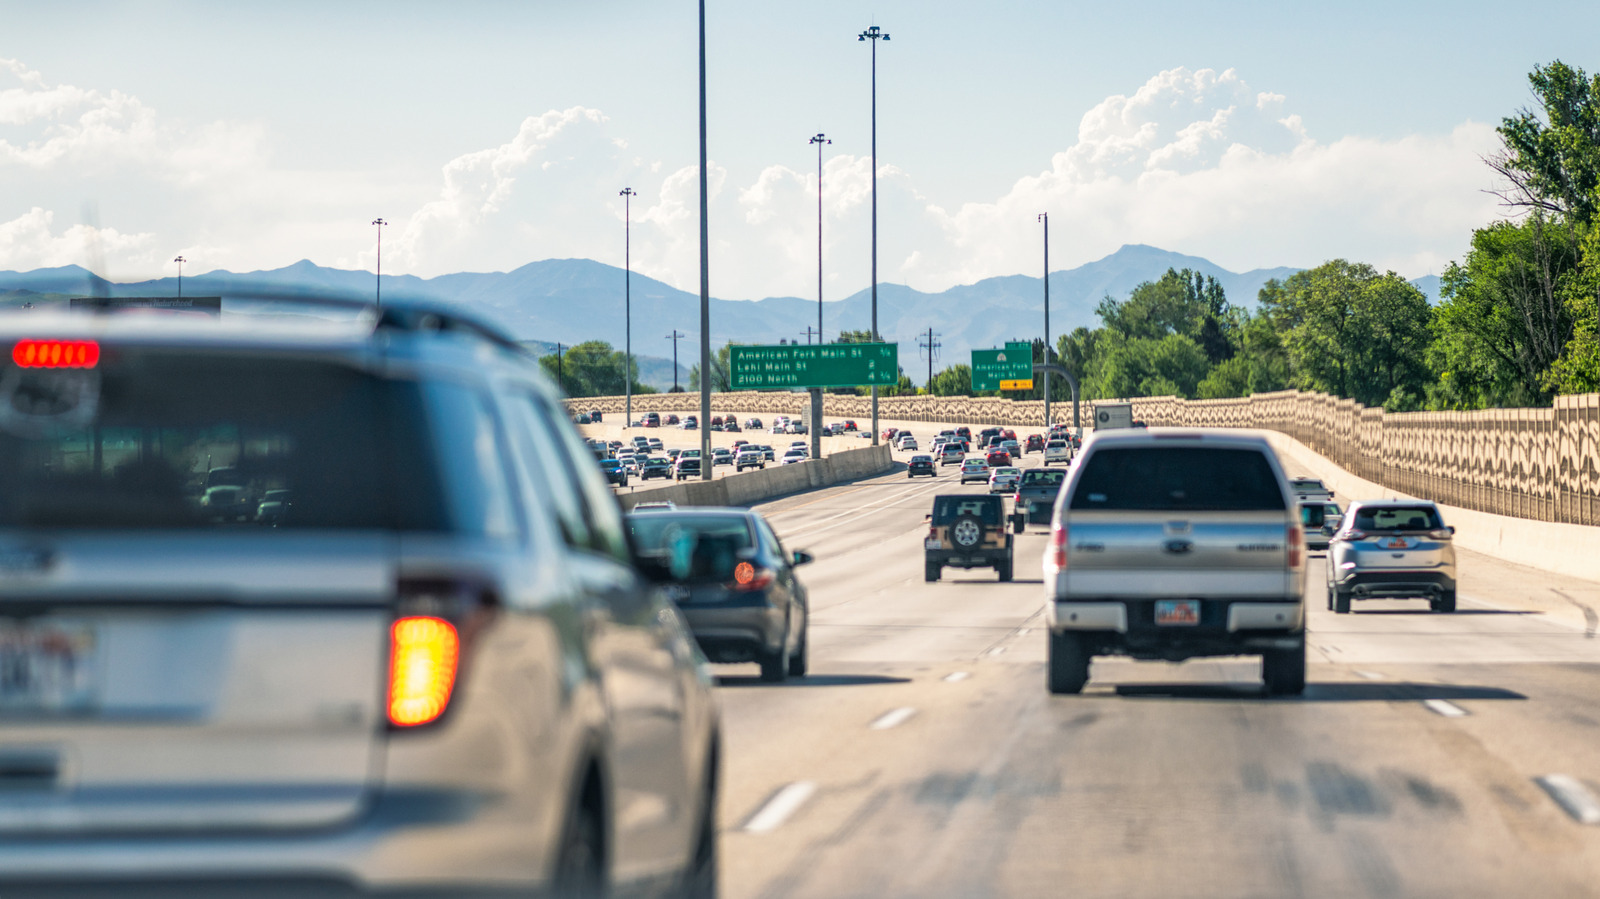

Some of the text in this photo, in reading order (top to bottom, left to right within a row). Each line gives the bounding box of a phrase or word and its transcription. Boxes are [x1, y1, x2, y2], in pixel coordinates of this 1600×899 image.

[738, 350, 788, 360] American
[793, 349, 815, 359] Fork
[821, 348, 846, 358] Main
[851, 347, 862, 358] St
[738, 362, 760, 372] Lehi
[765, 361, 790, 372] Main
[796, 361, 807, 371] St
[738, 374, 762, 385] 2100
[767, 373, 798, 384] North
[868, 371, 875, 381] 4
[988, 371, 1005, 379] Main
